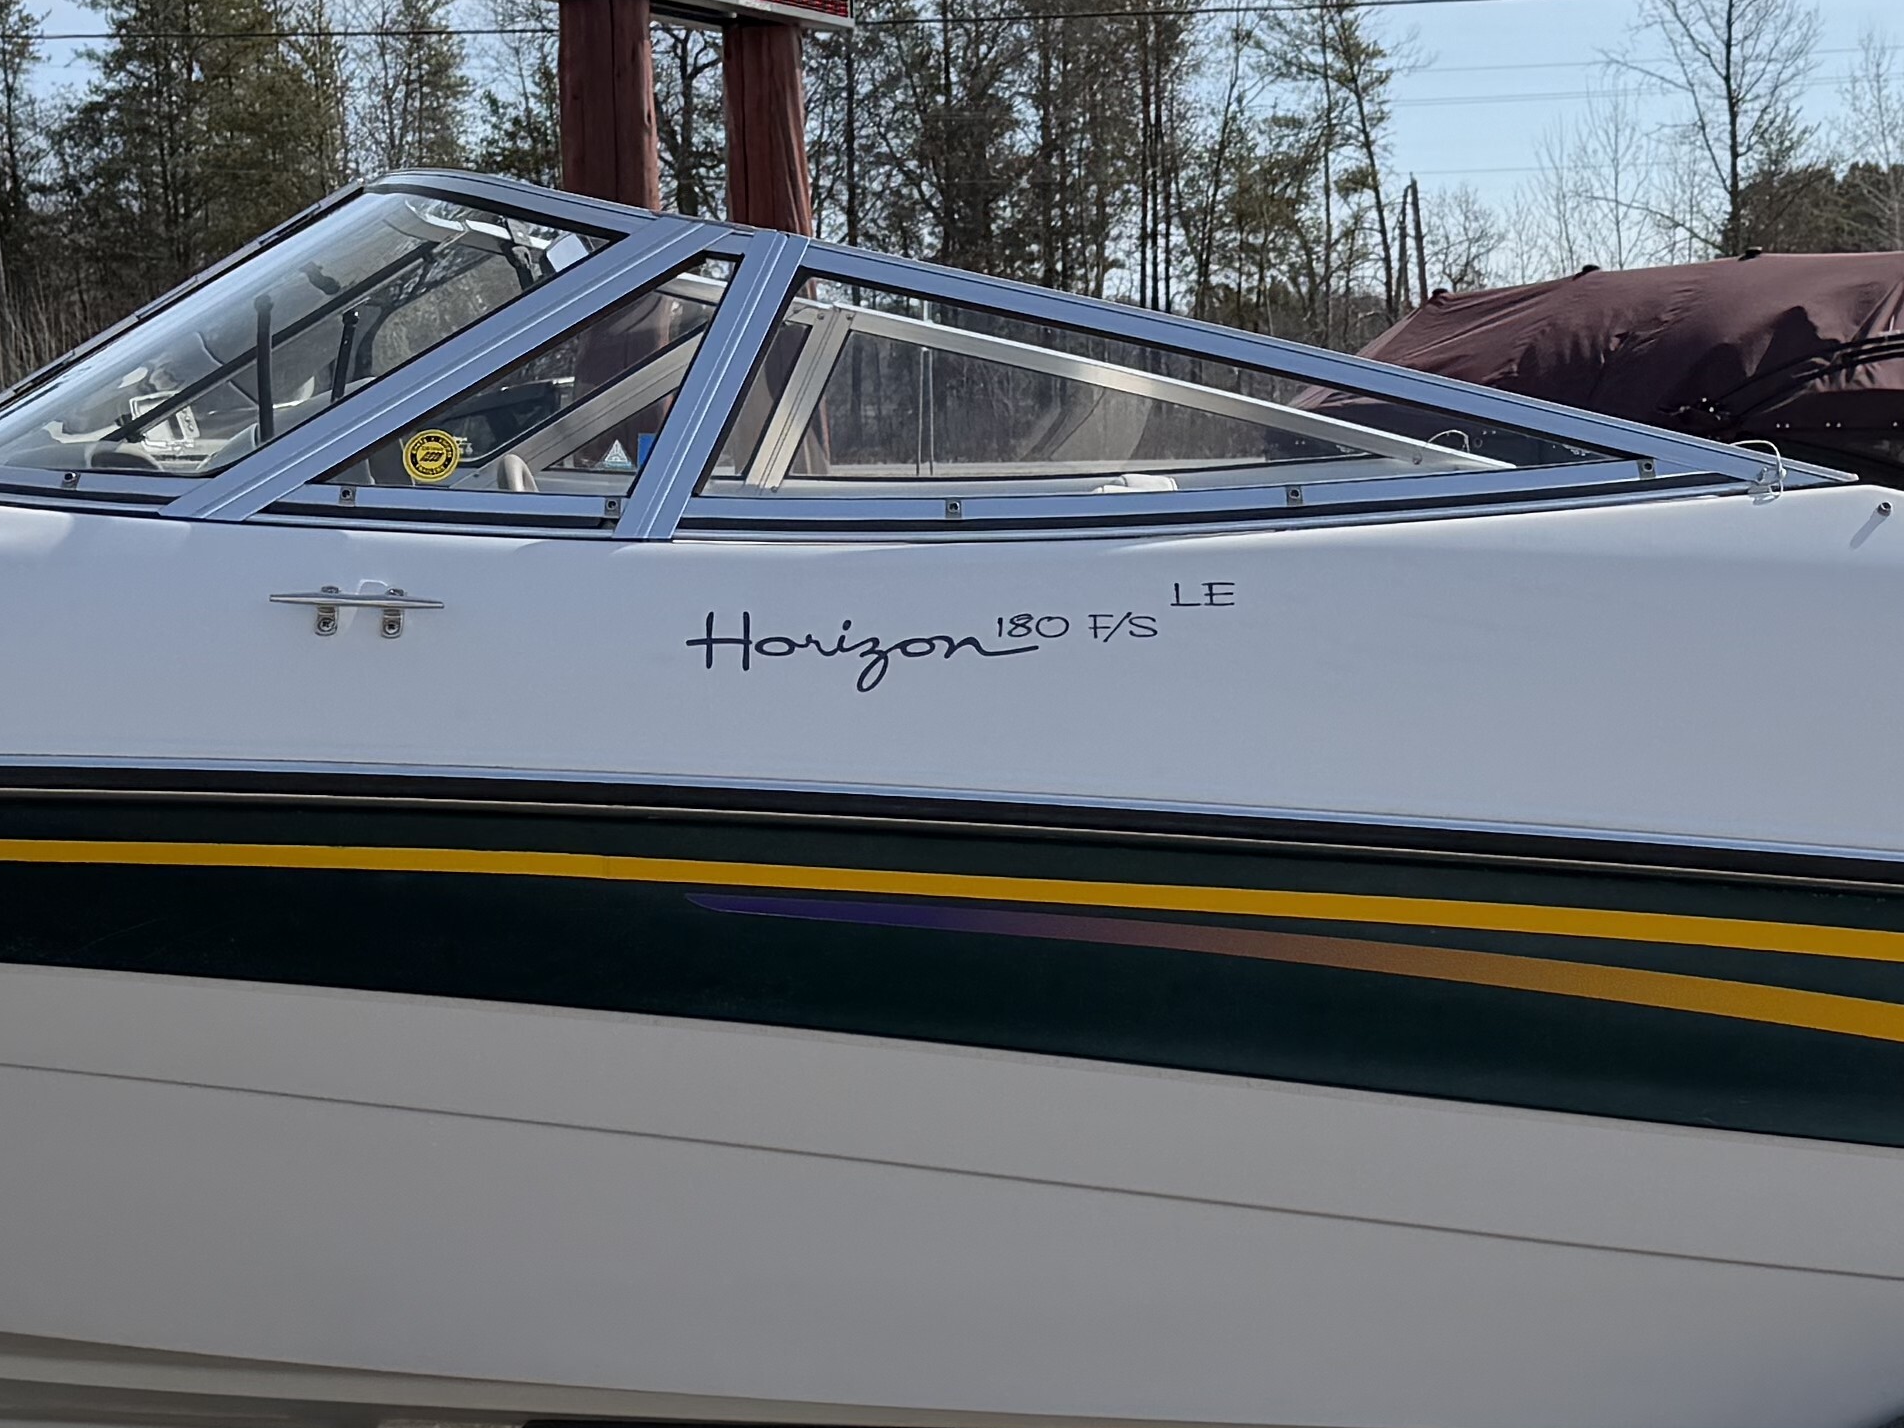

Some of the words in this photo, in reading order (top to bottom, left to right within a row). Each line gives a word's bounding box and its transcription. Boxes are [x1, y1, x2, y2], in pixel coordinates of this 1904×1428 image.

[686, 610, 1039, 692] Horizon
[996, 615, 1070, 640] 180
[1088, 614, 1159, 641] F/S
[1171, 581, 1236, 608] LE
